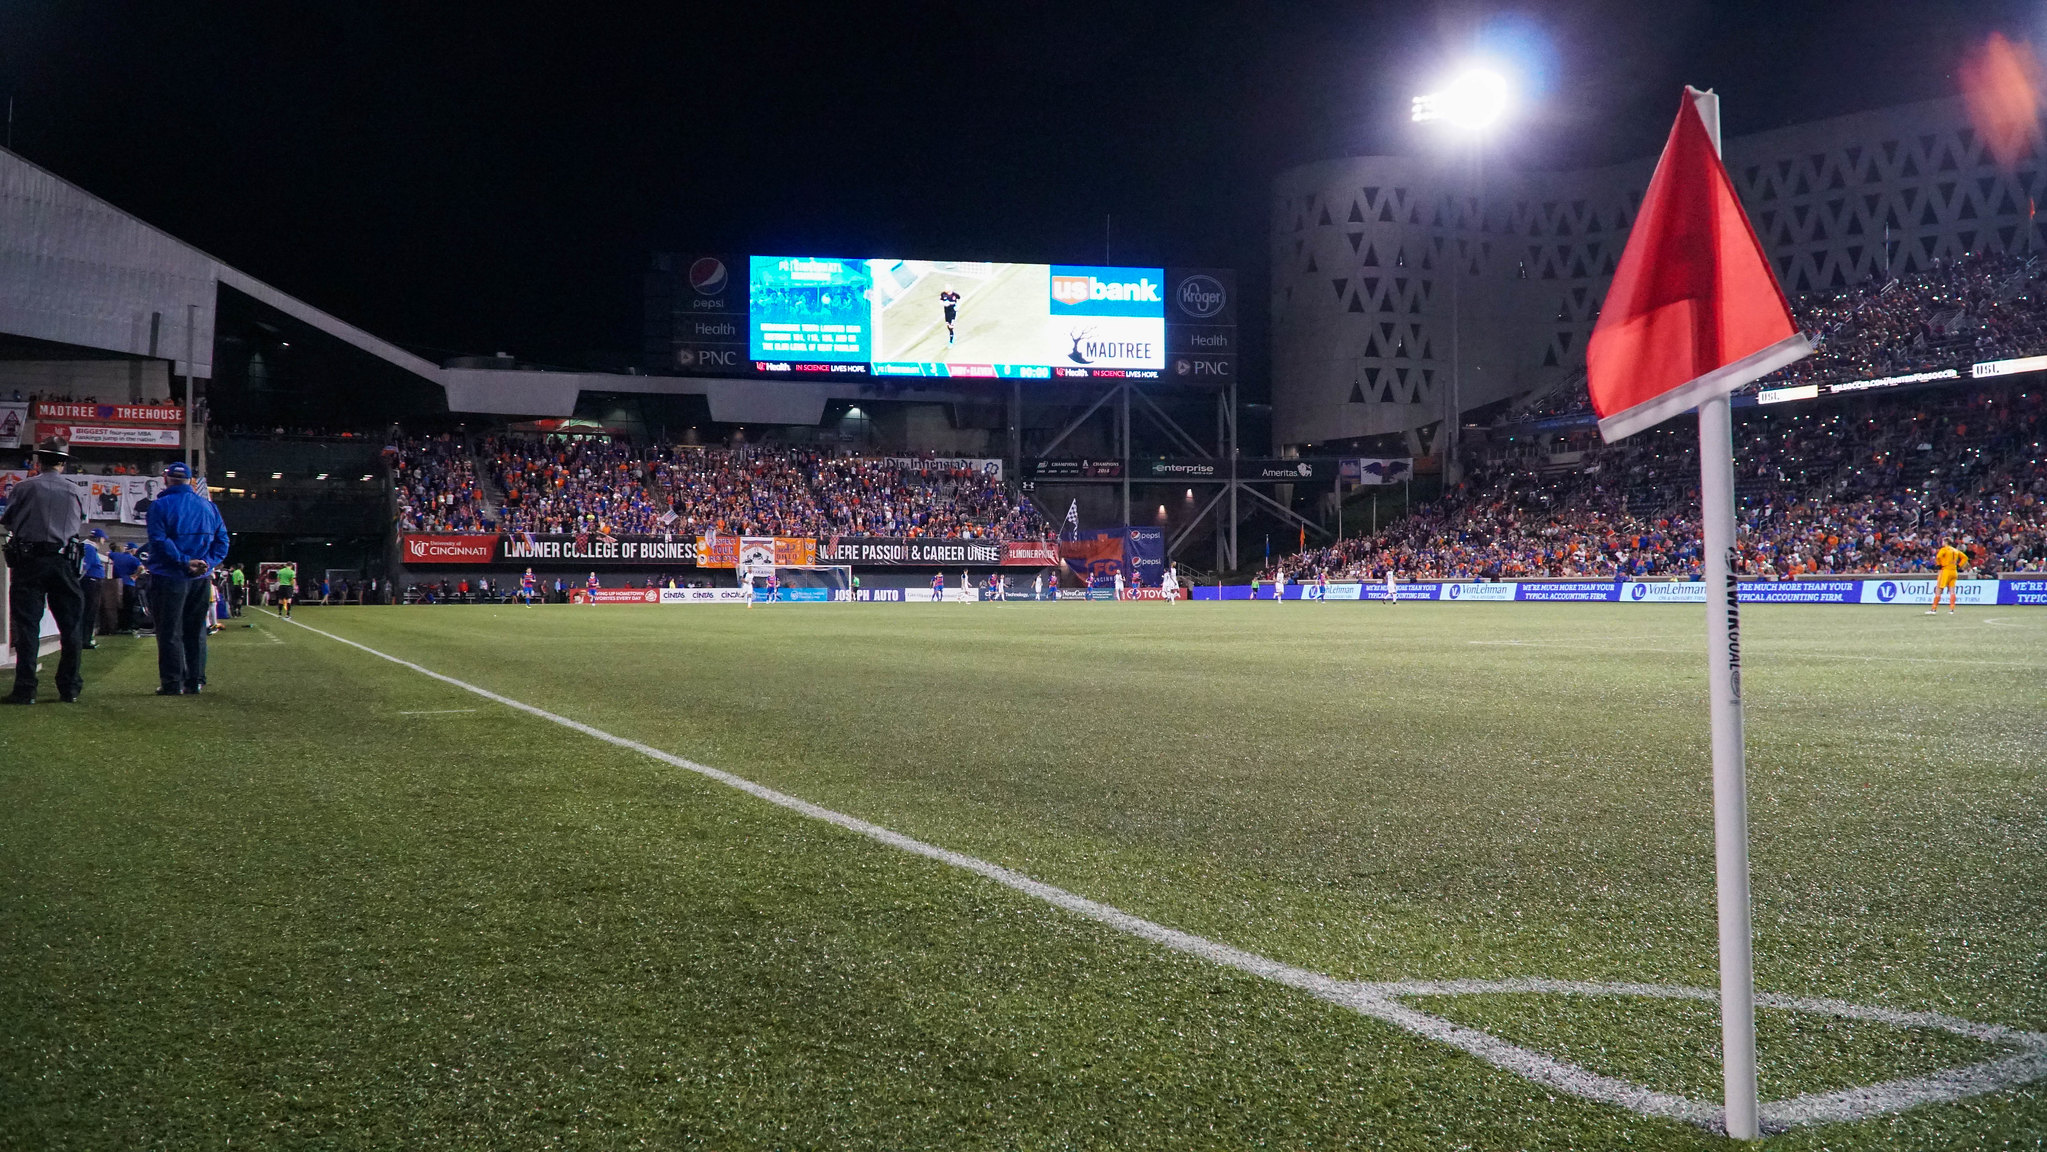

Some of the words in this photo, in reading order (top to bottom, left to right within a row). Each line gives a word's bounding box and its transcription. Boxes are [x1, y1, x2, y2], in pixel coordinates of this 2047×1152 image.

[1183, 283, 1221, 311] Kroger
[693, 299, 724, 310] pepsi
[695, 322, 736, 335] Health
[1192, 335, 1228, 346] Health
[1086, 342, 1152, 359] MADTREE
[698, 350, 737, 366] PNC
[1194, 361, 1229, 375] PNC
[39, 404, 95, 417] MADTREE
[116, 407, 182, 420] TREEHOUSE
[1156, 464, 1214, 476] enterprise
[1261, 468, 1298, 477] Ameritas
[1141, 533, 1161, 541] pepsi
[429, 547, 487, 556] CINCINNATI
[563, 542, 619, 558] COLEGE
[622, 543, 638, 558] OF
[640, 543, 698, 559] BUSINESS
[911, 545, 921, 560] &
[923, 546, 964, 560] CAREER
[967, 546, 1000, 561] UNITE
[708, 555, 739, 563] ROOTS
[1142, 559, 1162, 567] pepsi
[1094, 561, 1117, 576] FC
[1462, 584, 1507, 594] VonLehman
[1737, 583, 1752, 591] E'RE
[1753, 583, 1777, 591] MUCH
[1778, 583, 1801, 591] MORE
[1803, 583, 1828, 591] THAN
[1829, 583, 1853, 591] YOUR
[2010, 581, 2044, 591] WE'RE
[873, 590, 899, 601] AUTO
[1738, 593, 1766, 601] YPICAL
[1767, 593, 1819, 601] ACCOUNTING
[1820, 593, 1844, 601] FIRM.
[2017, 594, 2047, 603] TYPIC
